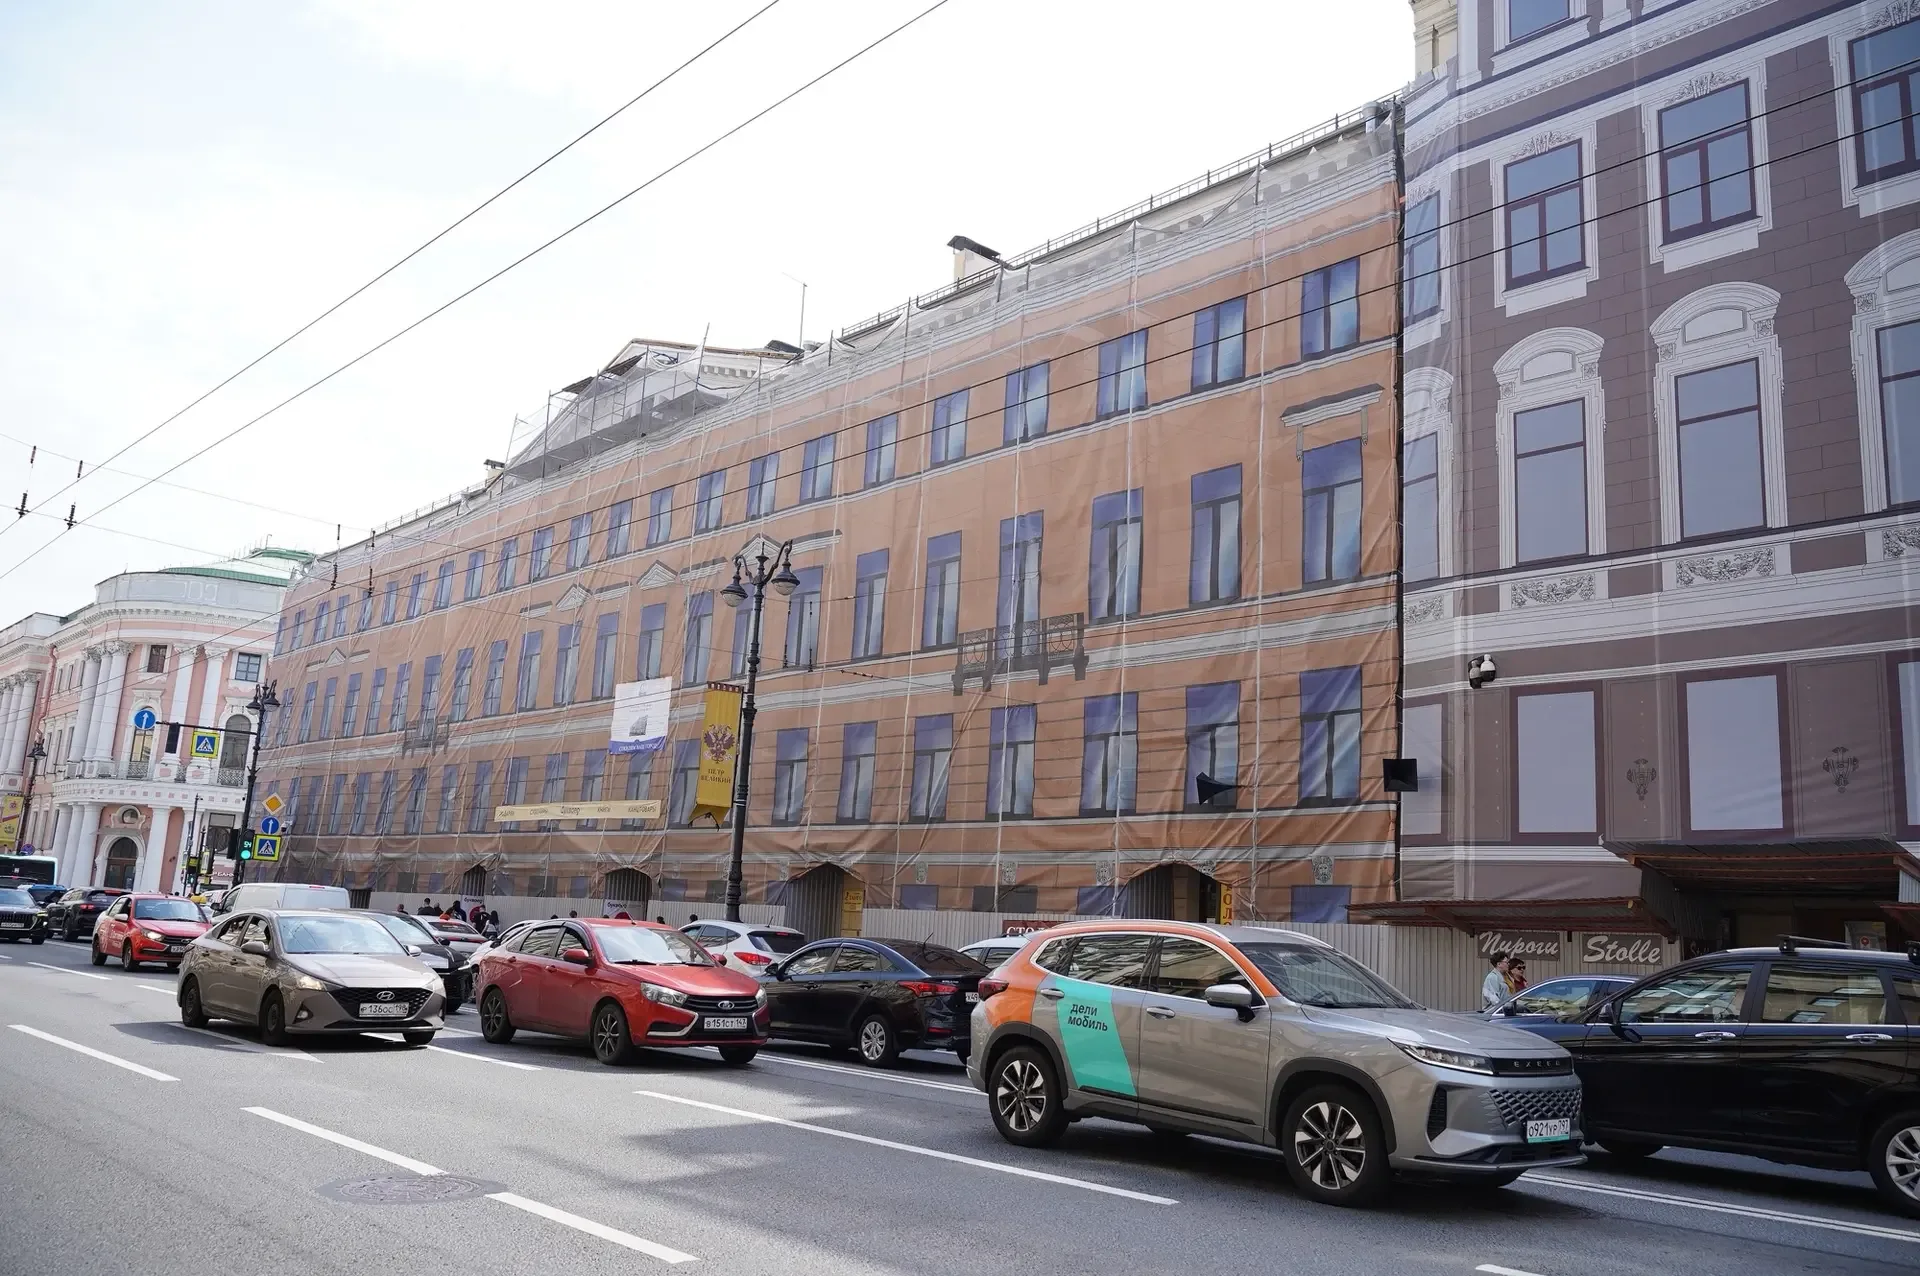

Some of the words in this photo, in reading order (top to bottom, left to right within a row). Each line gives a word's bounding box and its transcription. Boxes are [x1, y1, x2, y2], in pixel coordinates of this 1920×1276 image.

[708, 768, 725, 776] ПЕТР
[700, 775, 731, 784] ВЕЛИКИЙ
[1583, 935, 1661, 963] Stolle
[1070, 1003, 1098, 1016] дели
[1067, 1015, 1108, 1032] мобиль
[1513, 1060, 1560, 1068] EXEED
